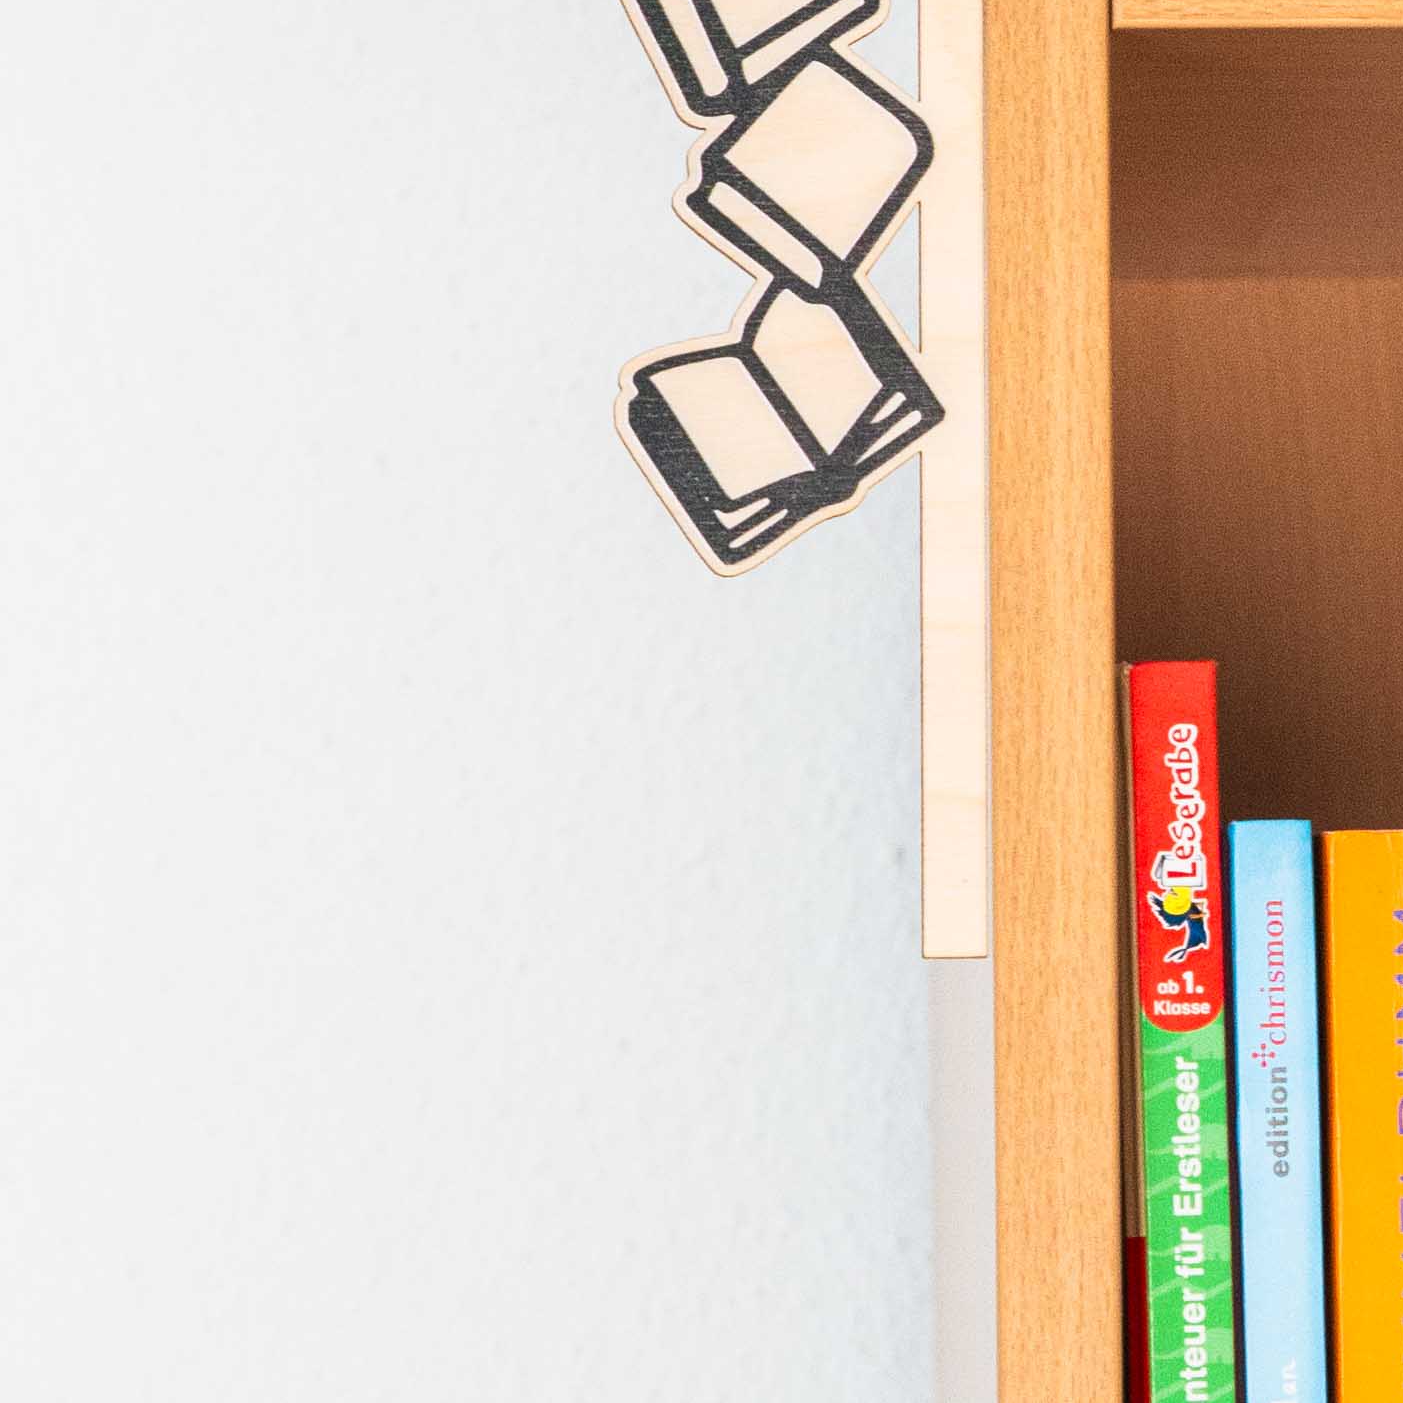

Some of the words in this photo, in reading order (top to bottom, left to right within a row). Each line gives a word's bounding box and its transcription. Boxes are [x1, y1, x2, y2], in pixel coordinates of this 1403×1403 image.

[1165, 724, 1201, 880] Leserabe
[1153, 1000, 1211, 1016] Klasse
[1157, 981, 1179, 995] ab
[1182, 971, 1205, 995] 1.
[1260, 900, 1288, 1046] chrismon
[1171, 1055, 1204, 1217] Erstleser
[1266, 1066, 1290, 1178] edition
[1174, 1227, 1205, 1278] für
